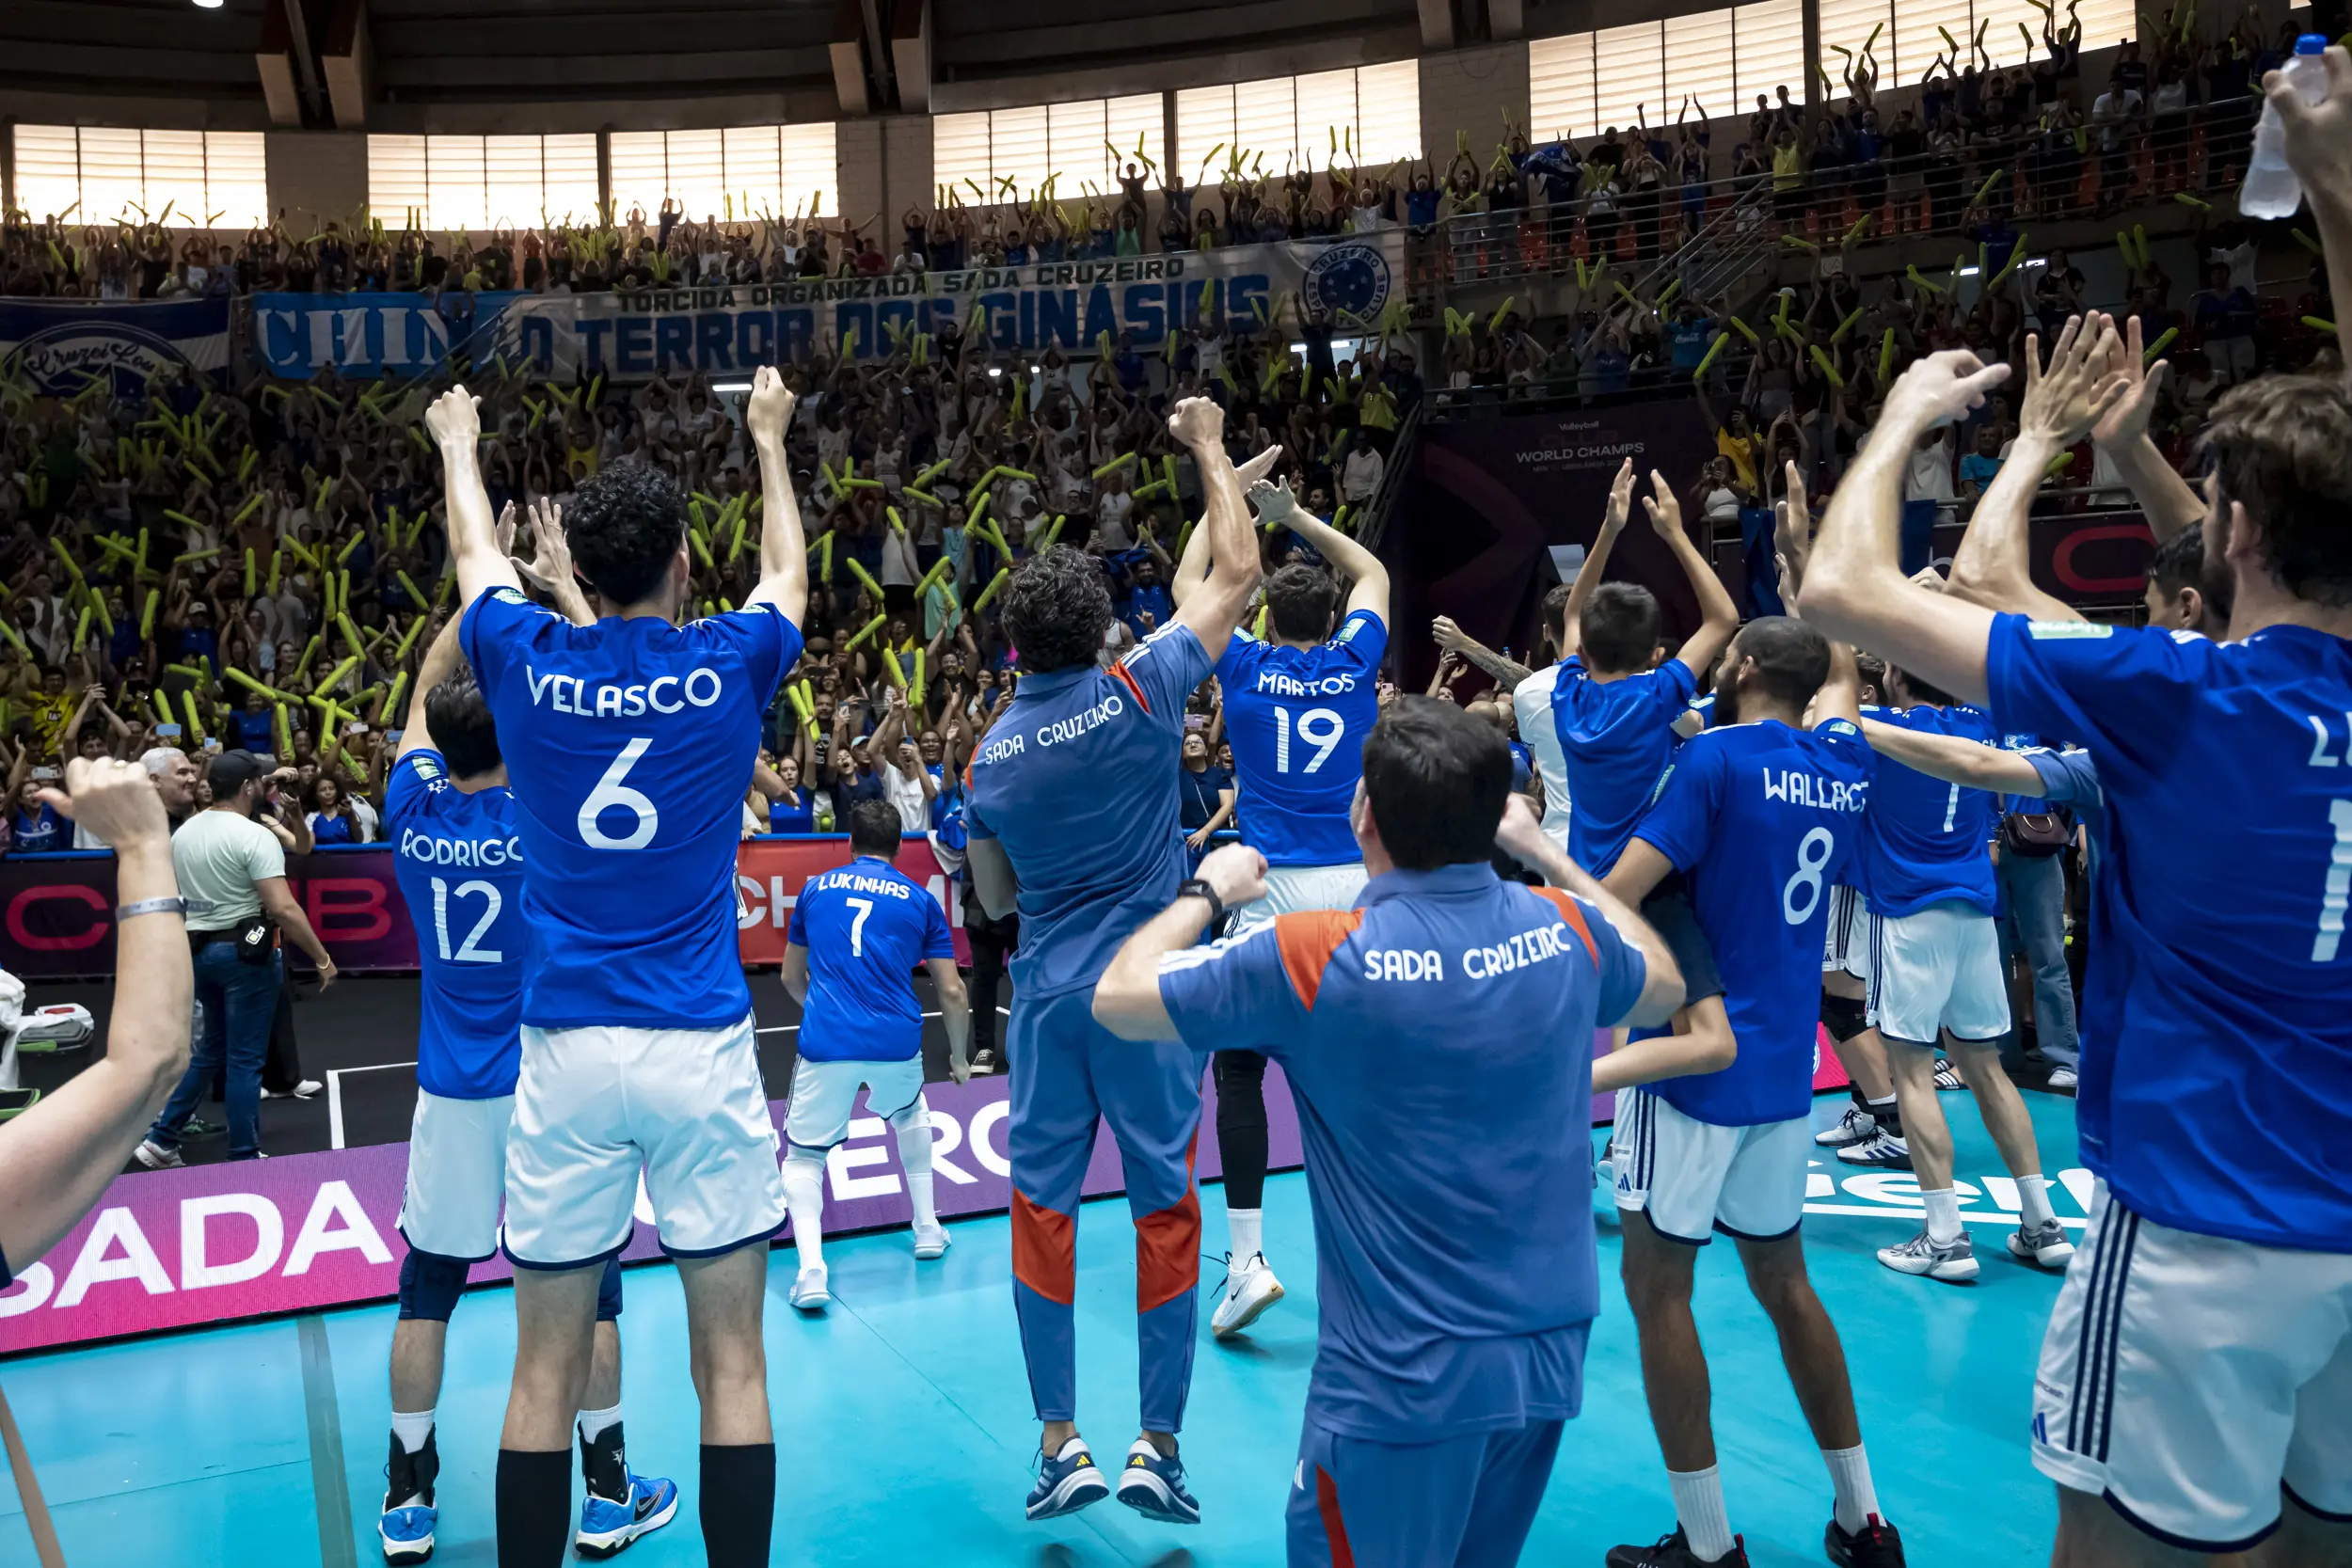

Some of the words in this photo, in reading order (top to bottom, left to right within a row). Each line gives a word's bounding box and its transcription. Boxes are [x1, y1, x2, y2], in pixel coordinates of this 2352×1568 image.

[617, 285, 736, 312] TORCIDA
[753, 273, 927, 306] ORGANIZADA
[944, 269, 1020, 293] SADA
[1036, 258, 1184, 285] CRUZEIRO
[256, 307, 503, 368] CHIN
[575, 308, 814, 375] TERROR
[836, 298, 955, 359] DOS
[1516, 448, 1574, 464] WORLD
[1577, 442, 1645, 458] CHAMPS
[1558, 420, 1599, 432] Volleyball
[526, 664, 722, 718] VELASCO
[1257, 672, 1356, 697] MARTOS
[985, 734, 1025, 766] SADA
[1037, 695, 1123, 747] CRUZEIRO
[1274, 705, 1345, 774] 19
[577, 736, 659, 850] 6
[818, 873, 911, 900] LUKINHAS
[1783, 826, 1835, 926] 8
[431, 876, 502, 963] 12
[846, 897, 873, 958] 7
[1364, 949, 1444, 982] SADA
